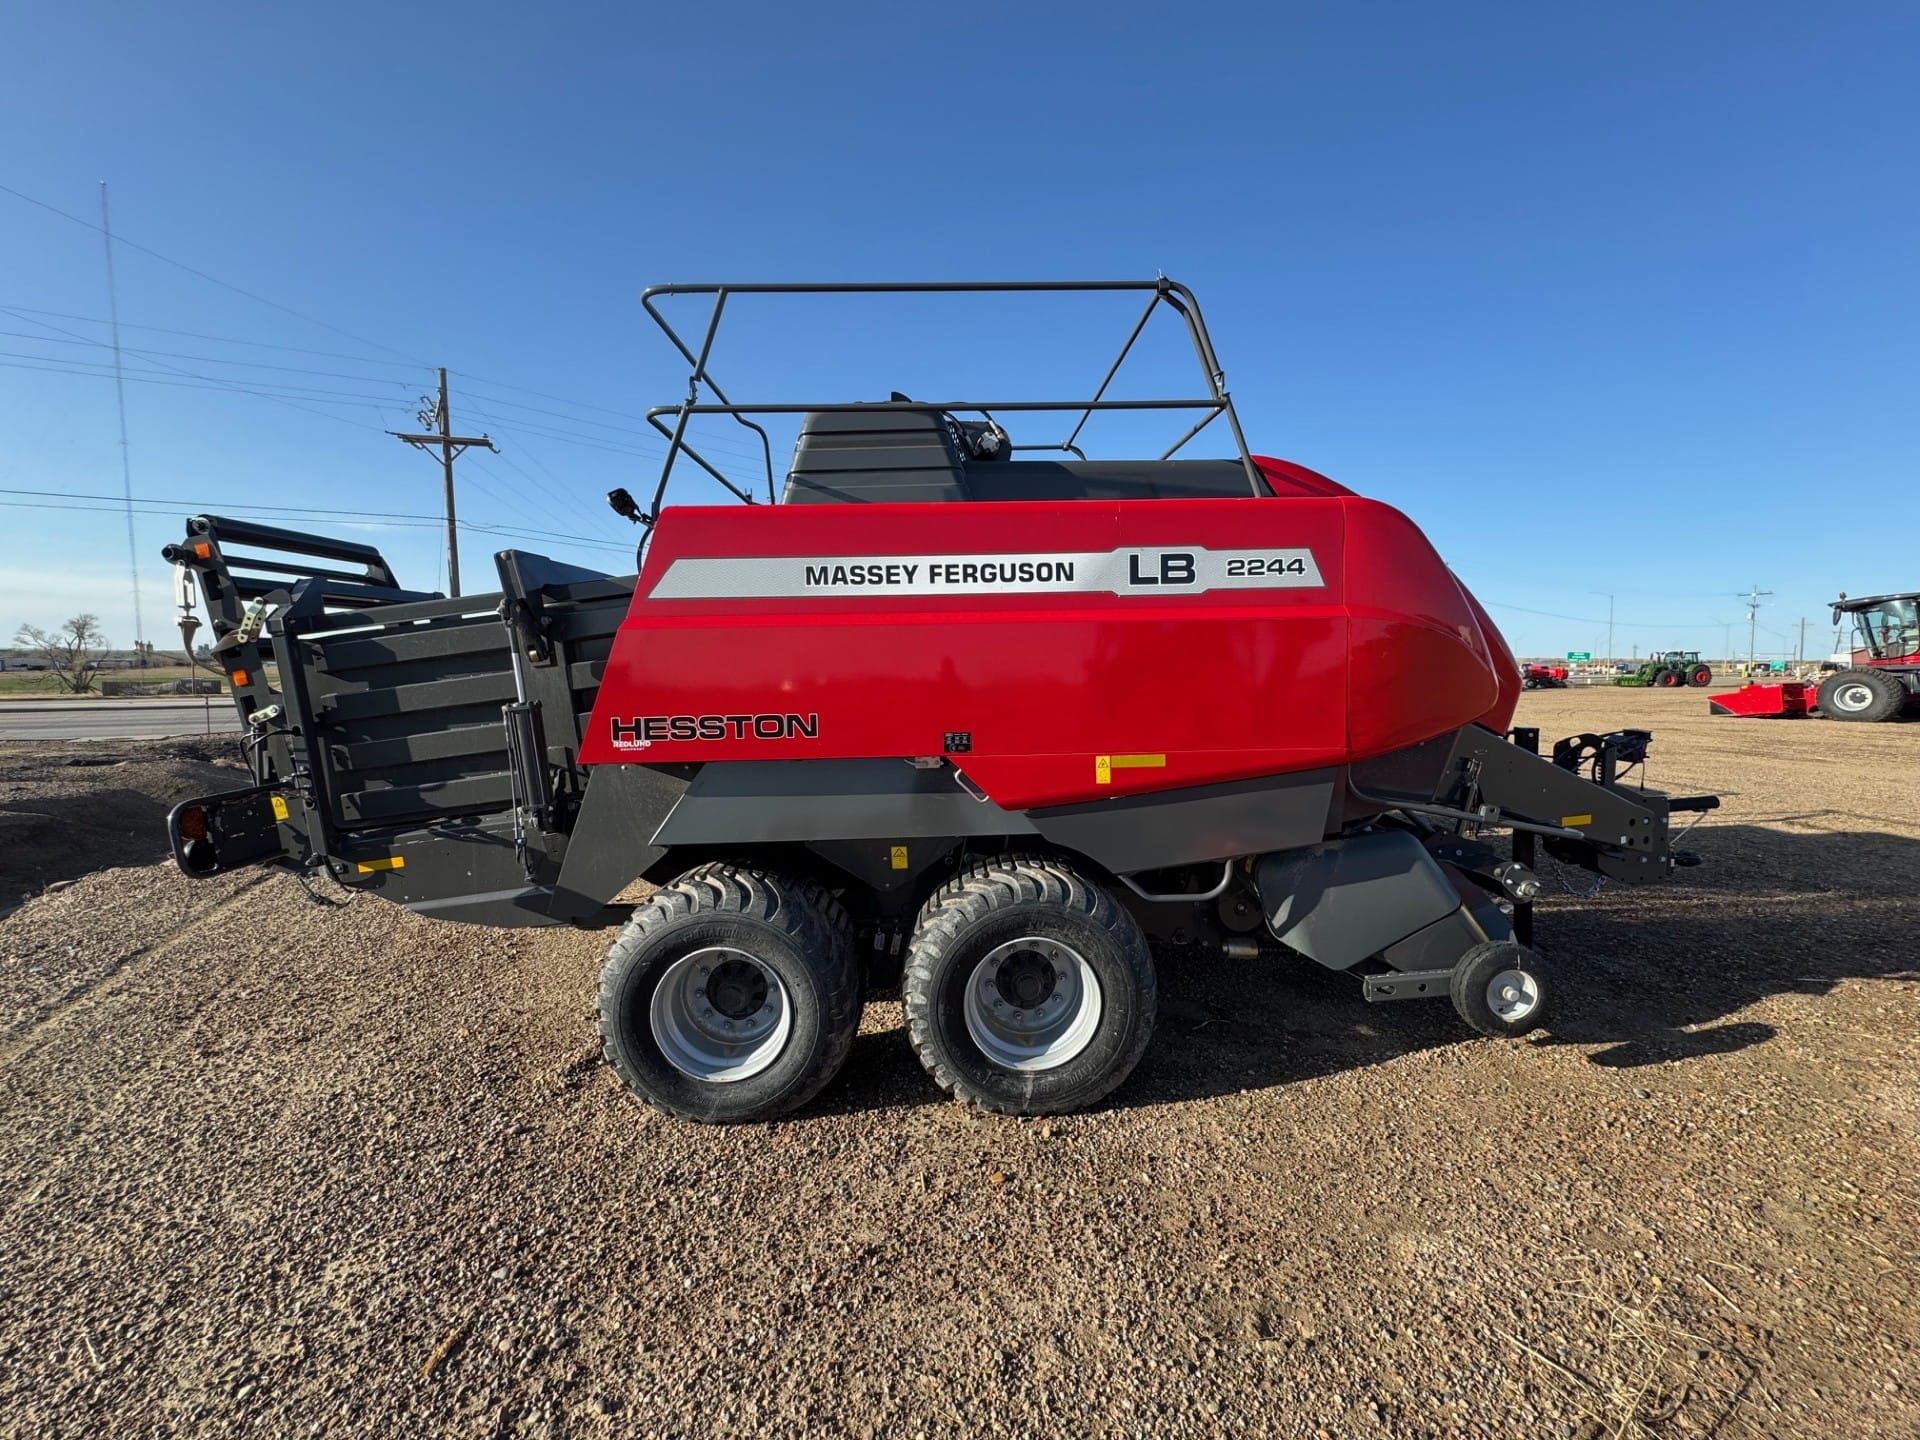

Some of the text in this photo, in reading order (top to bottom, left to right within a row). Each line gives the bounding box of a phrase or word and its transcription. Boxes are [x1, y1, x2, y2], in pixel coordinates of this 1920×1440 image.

[805, 561, 1075, 586] MASSEY FERGUSON
[1129, 553, 1196, 585] LB
[1226, 558, 1306, 577] 2244
[610, 713, 818, 741] HESSTON
[613, 740, 651, 748] REDLUND
